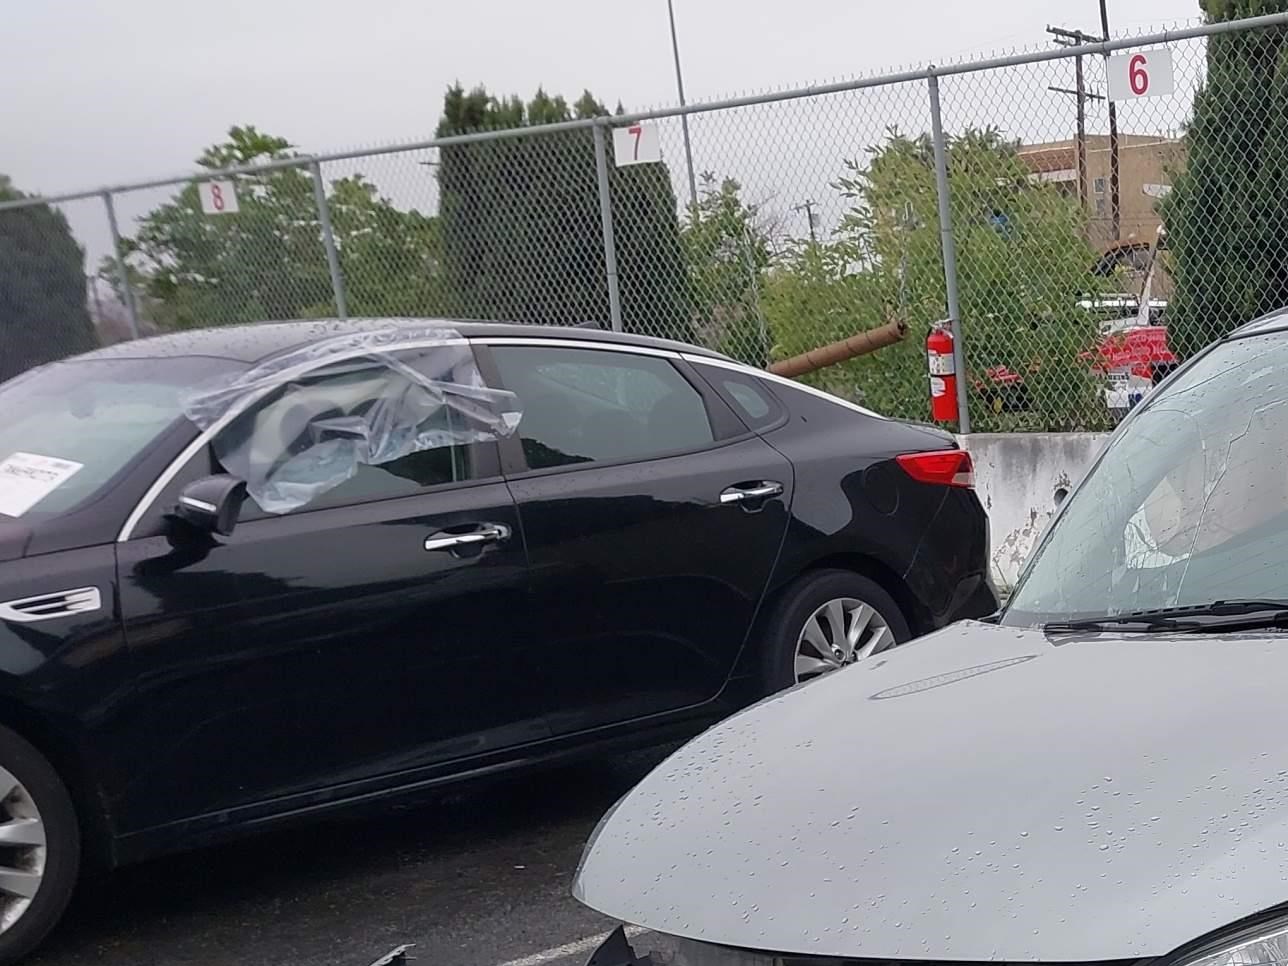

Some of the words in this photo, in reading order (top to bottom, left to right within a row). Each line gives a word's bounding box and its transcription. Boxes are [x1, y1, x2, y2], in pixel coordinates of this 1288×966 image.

[1128, 54, 1149, 95] 6
[627, 126, 642, 161] 7
[211, 184, 225, 210] 8
